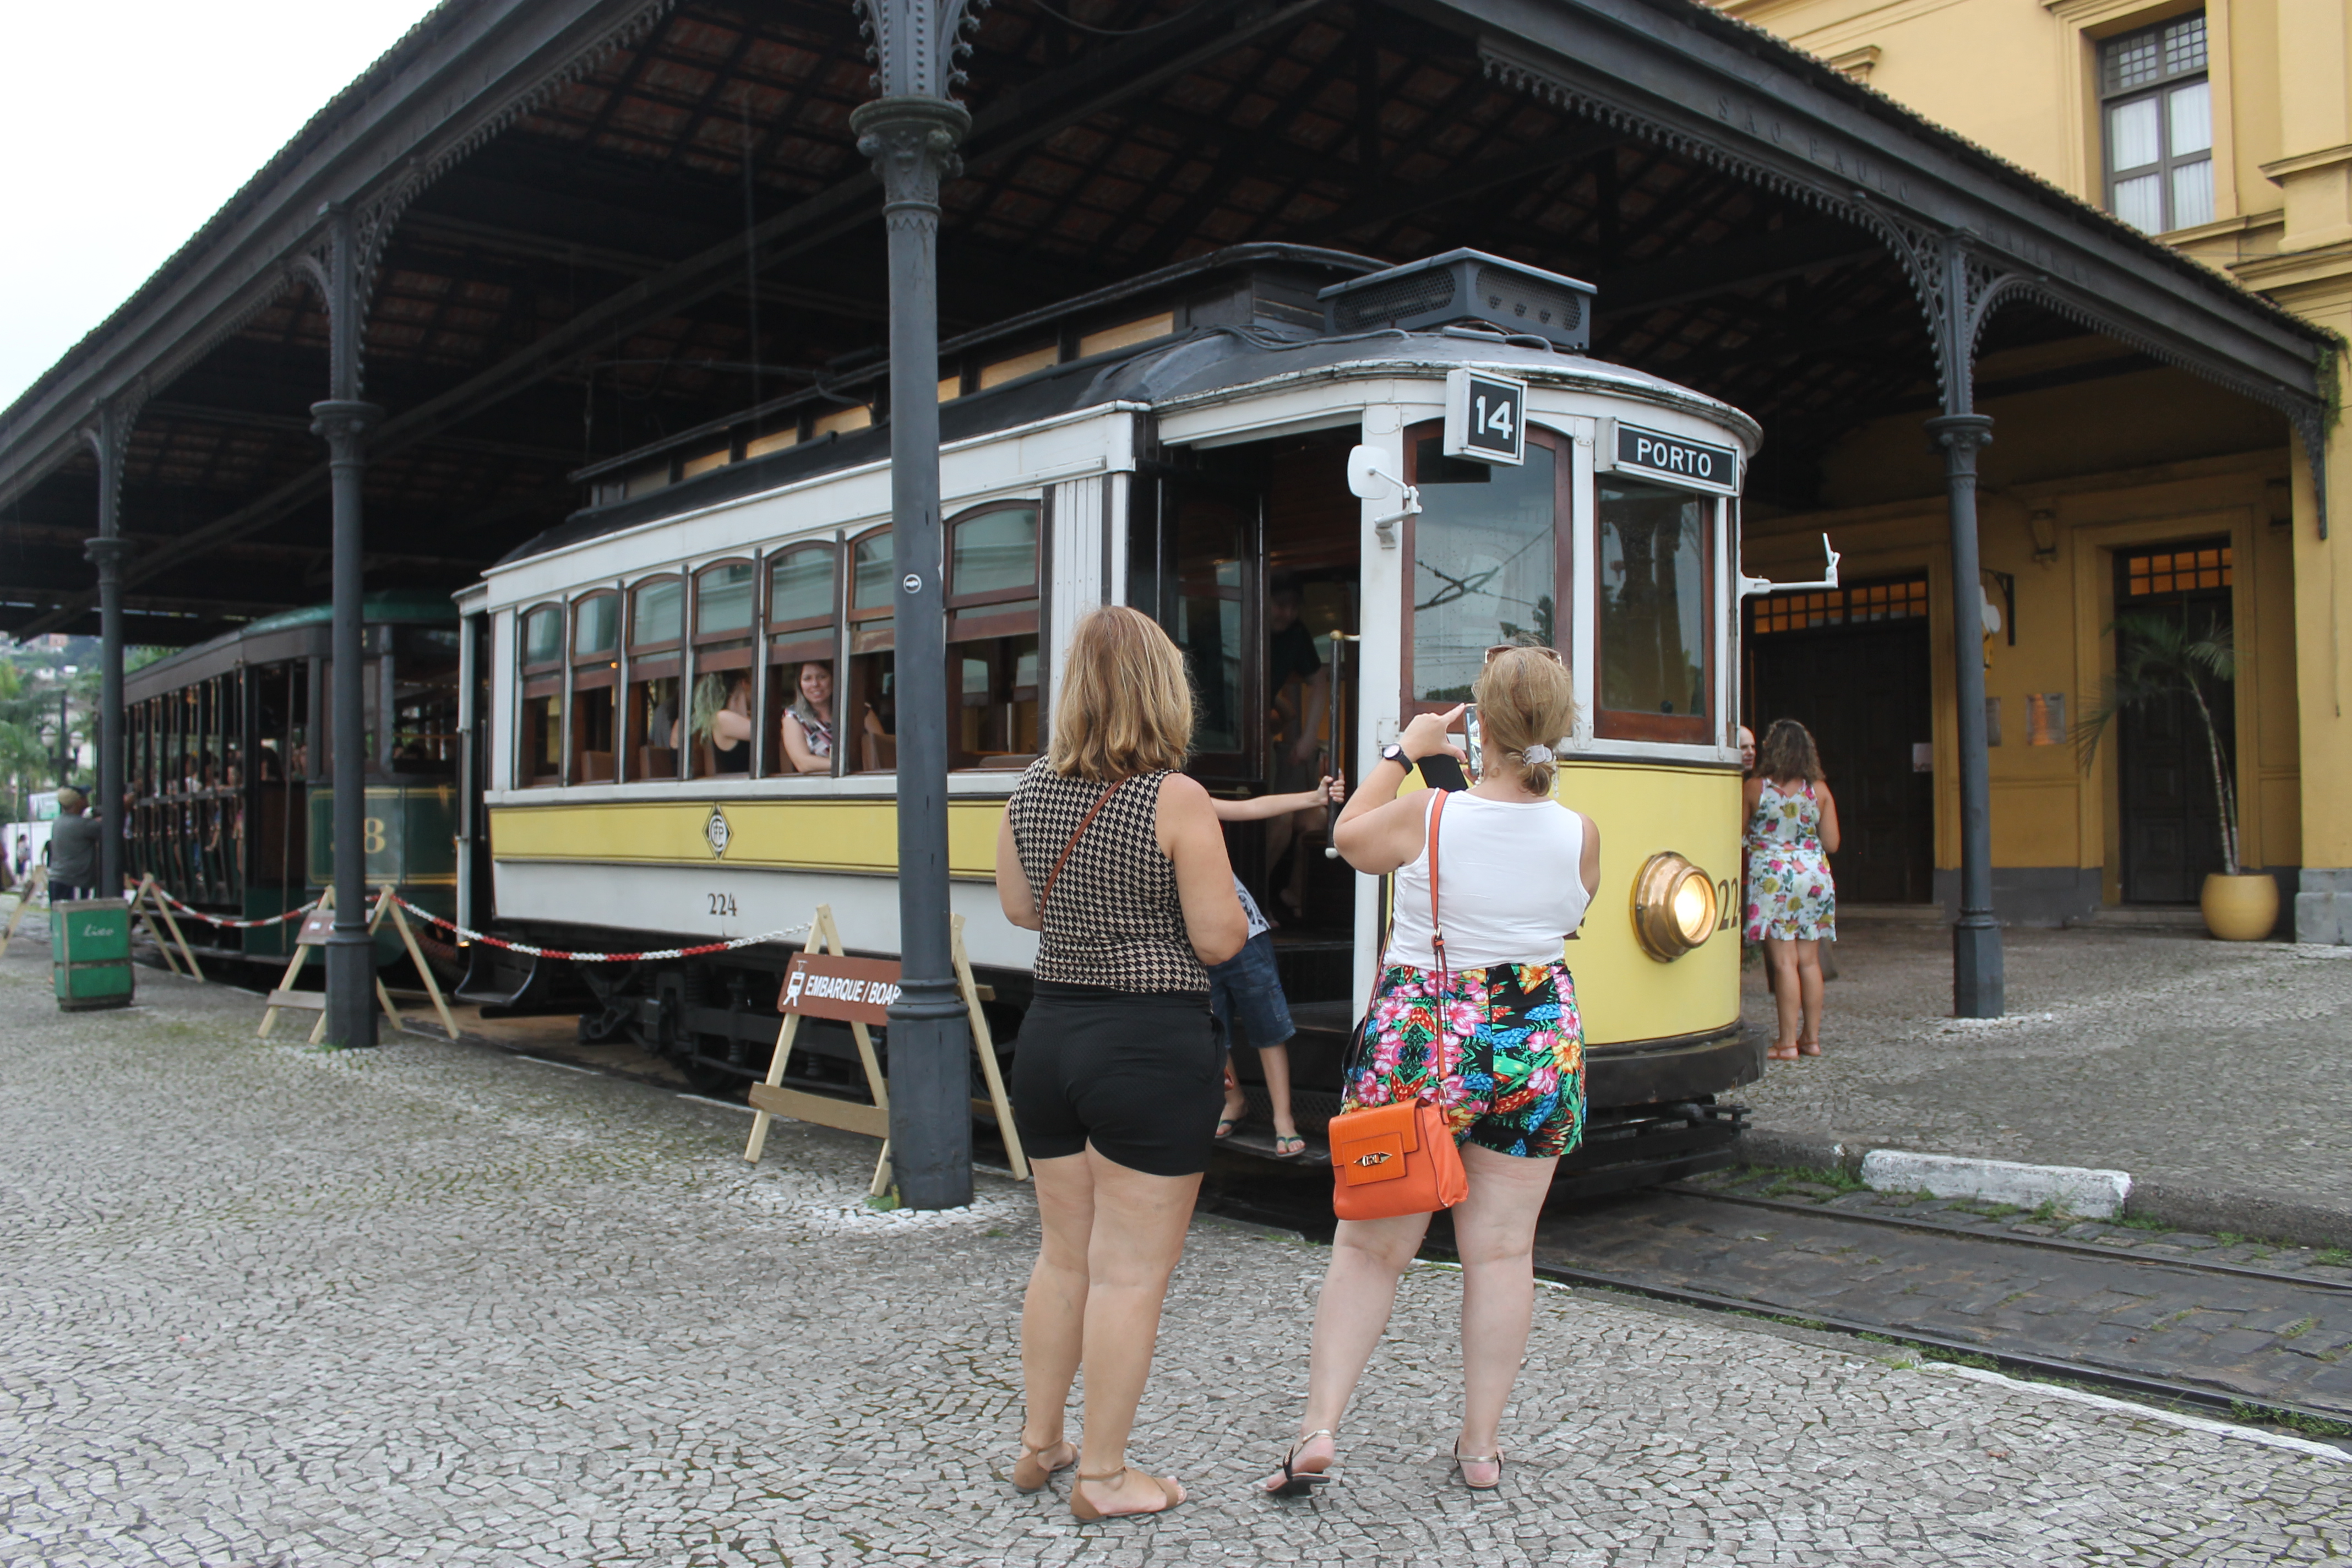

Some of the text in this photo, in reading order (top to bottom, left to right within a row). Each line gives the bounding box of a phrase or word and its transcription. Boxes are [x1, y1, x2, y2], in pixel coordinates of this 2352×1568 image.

[1809, 137, 1909, 203] PAULO
[1475, 395, 1513, 440] 14
[1637, 437, 1712, 477] PORTO
[708, 892, 737, 917] 224
[1718, 878, 1741, 931] 22
[804, 974, 865, 1002] EMBARQUE
